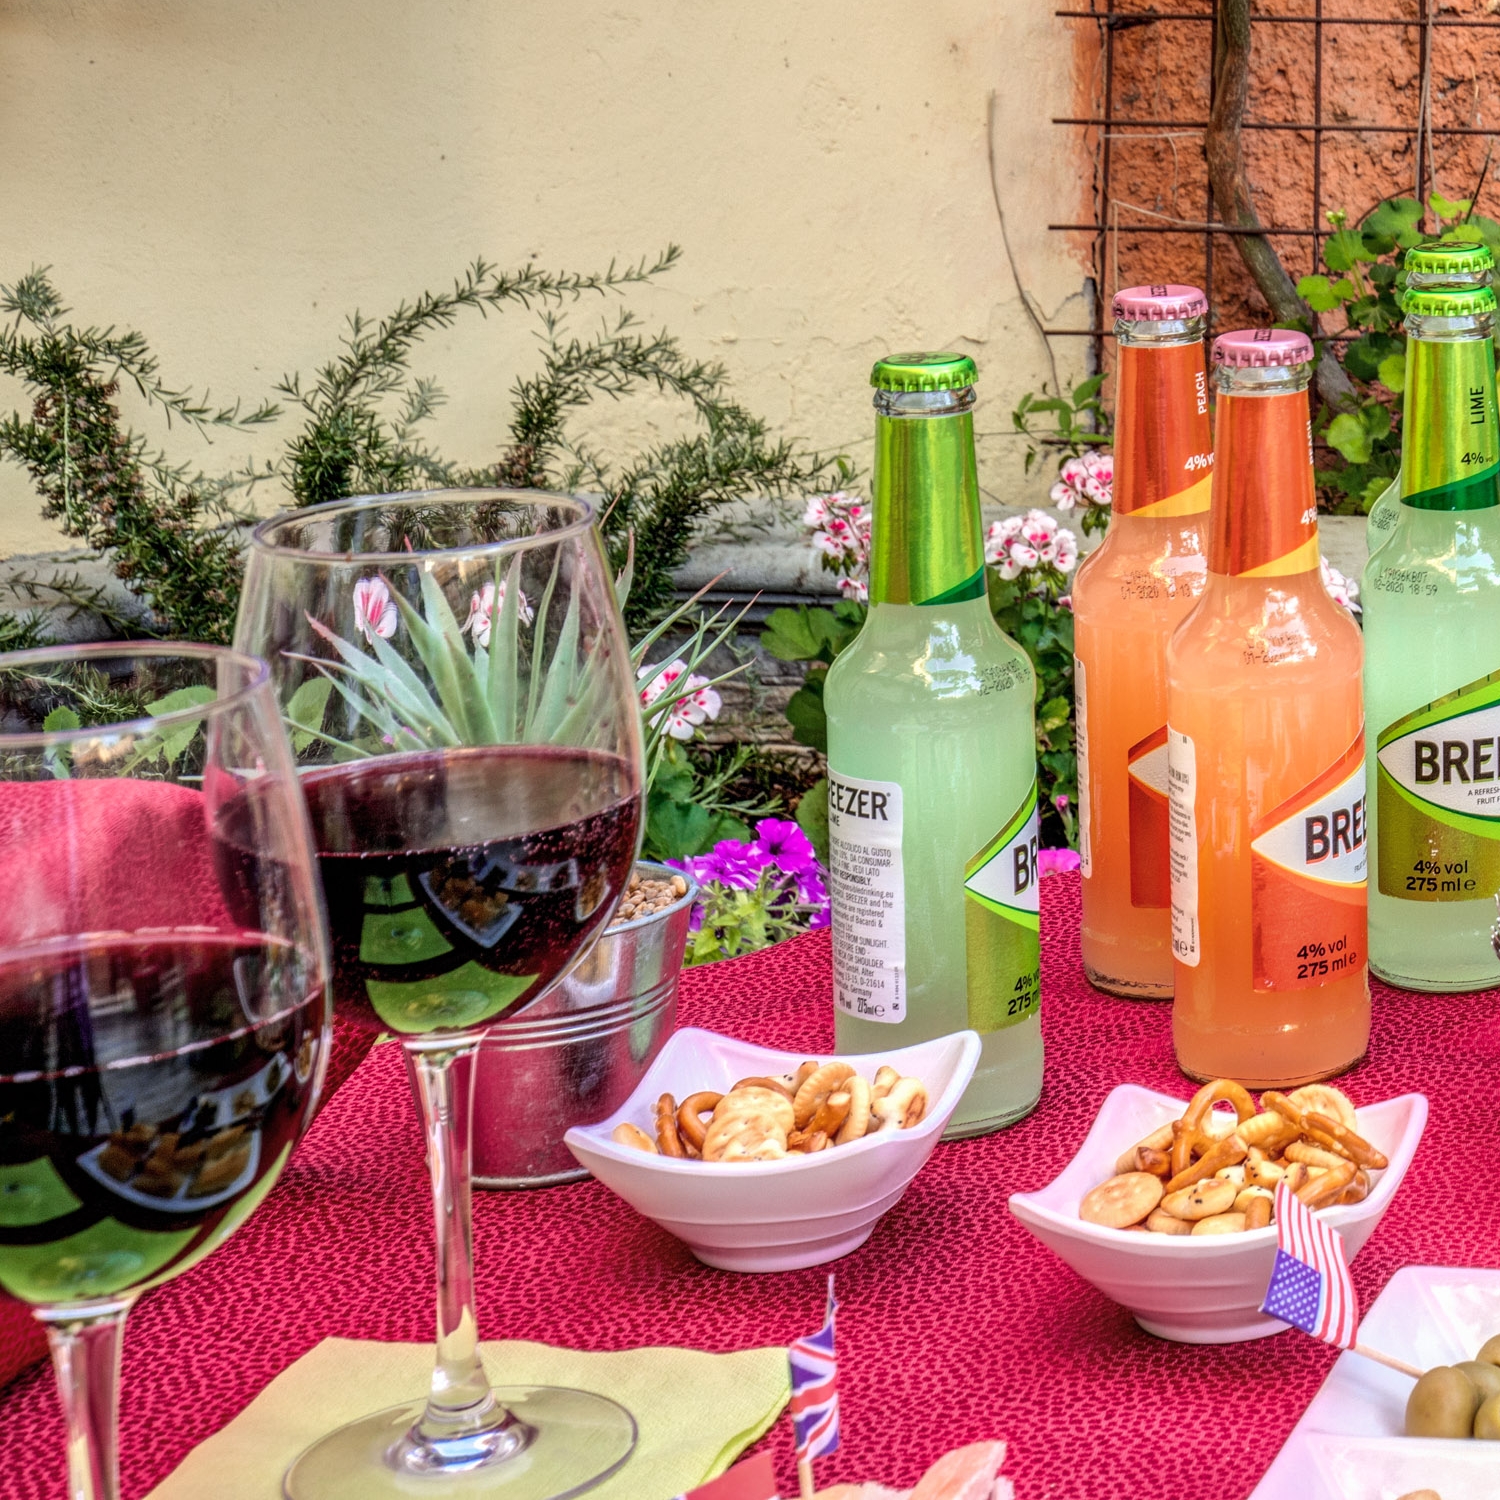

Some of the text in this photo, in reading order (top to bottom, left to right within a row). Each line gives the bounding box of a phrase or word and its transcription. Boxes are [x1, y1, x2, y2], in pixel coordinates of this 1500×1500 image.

[1195, 371, 1207, 414] PEACH
[1470, 385, 1484, 425] LIME
[1184, 454, 1207, 471] 4%
[1460, 452, 1484, 465] 4%
[1409, 583, 1438, 596] 18:59
[830, 779, 888, 821] EEZER
[1477, 797, 1496, 805] FRUIT
[863, 846, 870, 855] AL
[871, 847, 892, 858] GUSTO
[850, 853, 857, 862] DA
[857, 855, 894, 868] CONSUMAR-
[1414, 859, 1468, 875] 4% vol
[840, 870, 873, 886] RESPONSIBLY.
[853, 864, 864, 875] VEDI
[865, 867, 880, 877] LATO
[1406, 876, 1438, 892] 275
[1441, 878, 1460, 892] ml
[845, 892, 868, 906] BREEZER
[870, 899, 881, 908] and
[883, 900, 893, 909] the
[857, 908, 884, 918] registered
[856, 915, 876, 927] Bacardi
[878, 919, 883, 928] &
[845, 932, 858, 943] FROM
[859, 936, 890, 949] SUNLIGHT.
[1297, 935, 1347, 960] 4% vol
[855, 945, 866, 956] END
[854, 955, 884, 969] SHOULDER
[1297, 961, 1328, 979] 275
[1332, 954, 1347, 971] ml
[861, 967, 875, 977] Alter
[860, 976, 885, 988] D-21614
[1014, 974, 1033, 992] 4%
[850, 984, 872, 999] Germany
[1008, 990, 1031, 1016] 275
